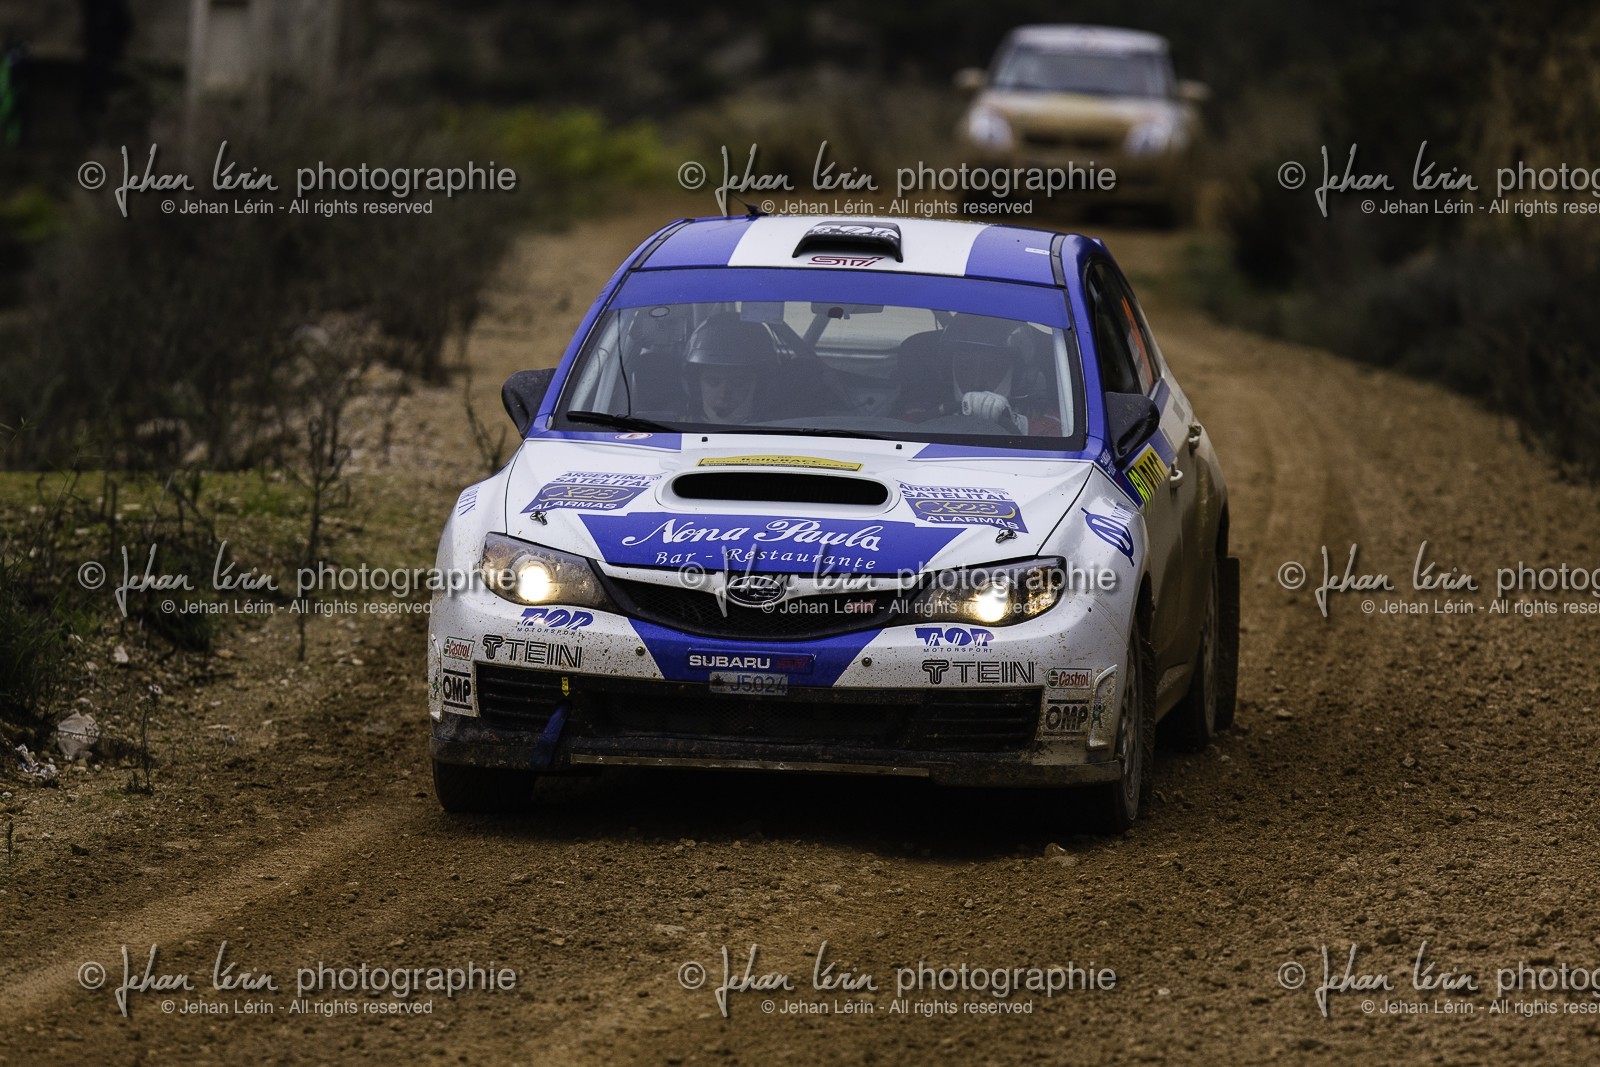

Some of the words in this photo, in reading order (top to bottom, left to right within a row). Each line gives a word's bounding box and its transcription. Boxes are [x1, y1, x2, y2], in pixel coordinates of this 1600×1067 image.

[551, 478, 652, 487] SATELITAL
[560, 472, 647, 480] ARGENTINA
[899, 483, 990, 494] ARGENTINA
[901, 490, 1013, 501] SATELITAL
[529, 500, 618, 511] ALARMAS
[926, 515, 1020, 530] ALARMAS
[621, 518, 751, 546] Nona
[753, 518, 885, 551] Paula
[655, 551, 697, 564] Bar
[725, 548, 876, 569] Restaurante
[516, 627, 583, 637] MOTORSPORT
[449, 639, 471, 658] Castrol
[504, 638, 583, 669] TEIN
[689, 655, 771, 669] SUBARU
[952, 661, 1035, 684] TEIN
[1058, 671, 1089, 687] Castrol
[443, 675, 472, 703] OMP
[1045, 705, 1089, 730] OMP
